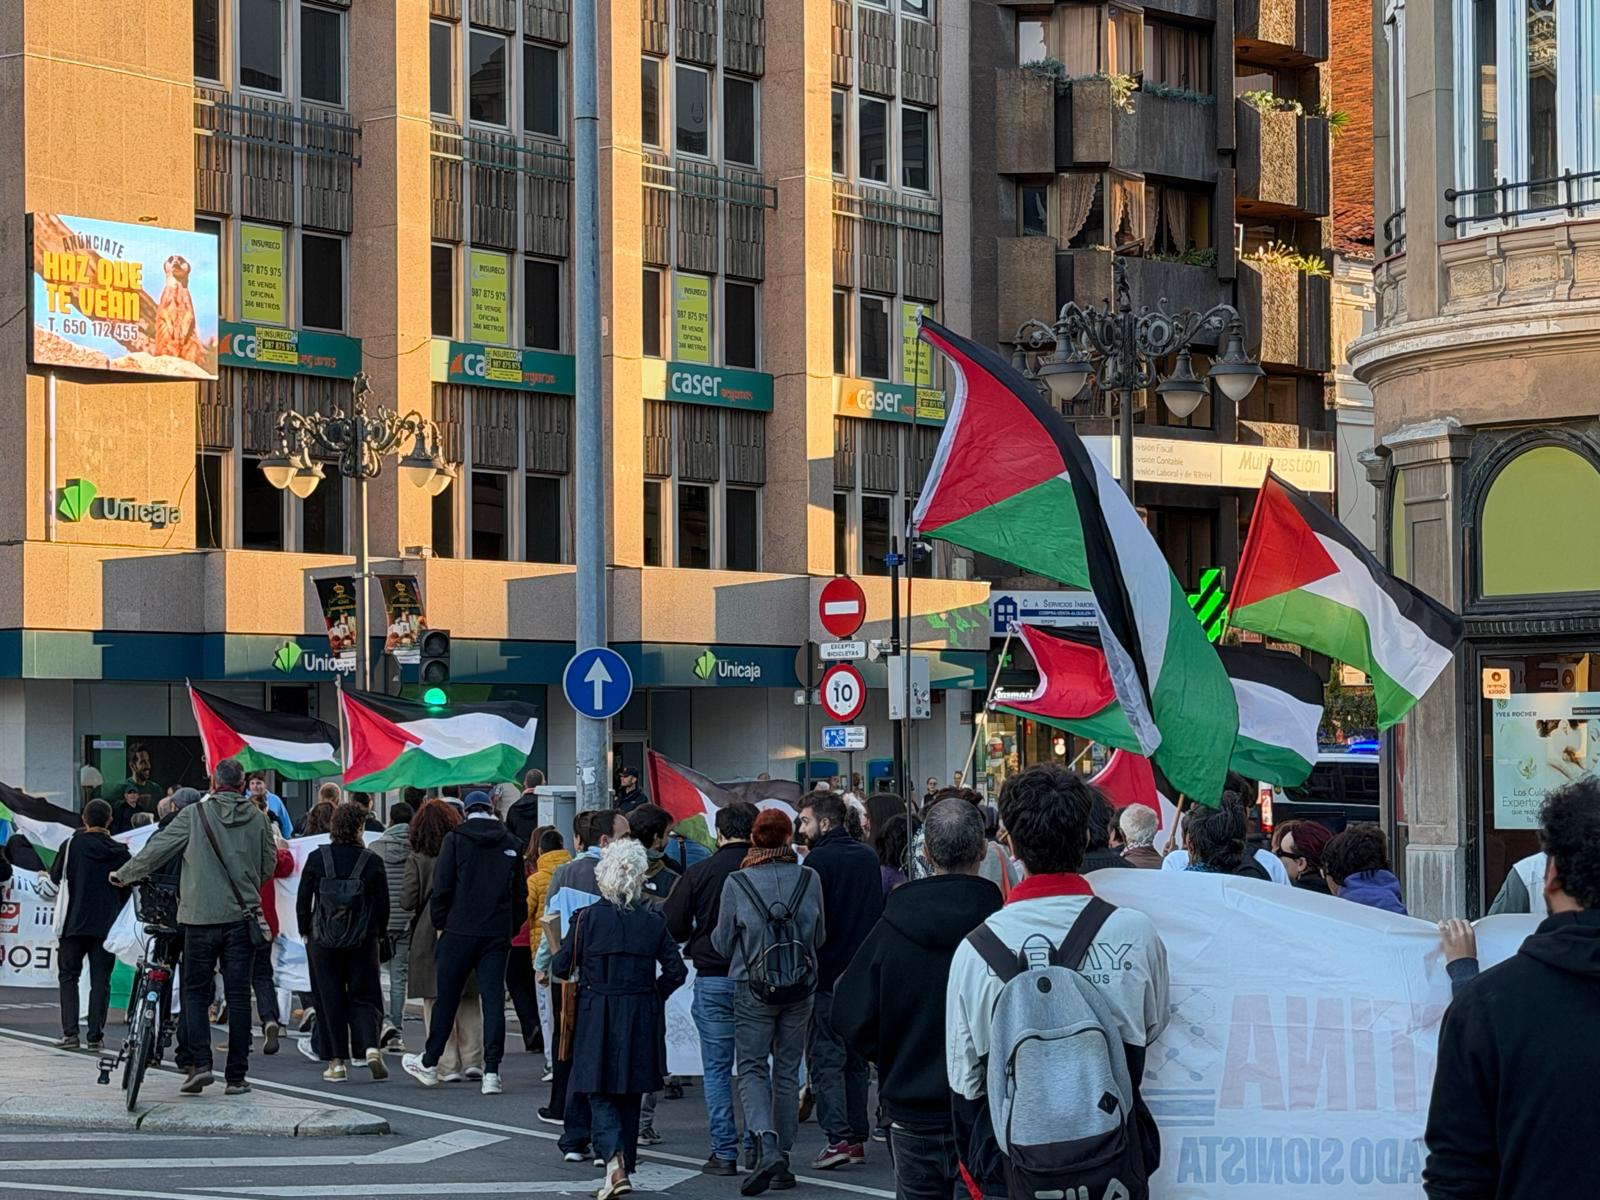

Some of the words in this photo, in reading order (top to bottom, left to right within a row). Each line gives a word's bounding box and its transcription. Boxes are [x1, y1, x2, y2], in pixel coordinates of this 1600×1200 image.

[251, 239, 280, 250] INSURECO
[43, 250, 91, 284] HAZ
[97, 258, 143, 290] QUE
[256, 281, 276, 290] VENDE
[45, 282, 72, 314] TE
[79, 287, 140, 322] VEAN
[63, 319, 87, 335] 650
[92, 322, 111, 338] 172
[115, 324, 138, 340] 455
[264, 330, 293, 339] INSURECO
[672, 372, 722, 397] caser
[856, 389, 902, 413] caser
[103, 497, 181, 529] Unicaja
[718, 661, 761, 682] Unicaja
[833, 684, 853, 703] 10
[994, 687, 1034, 699] Farmaci
[1513, 787, 1526, 796] Los
